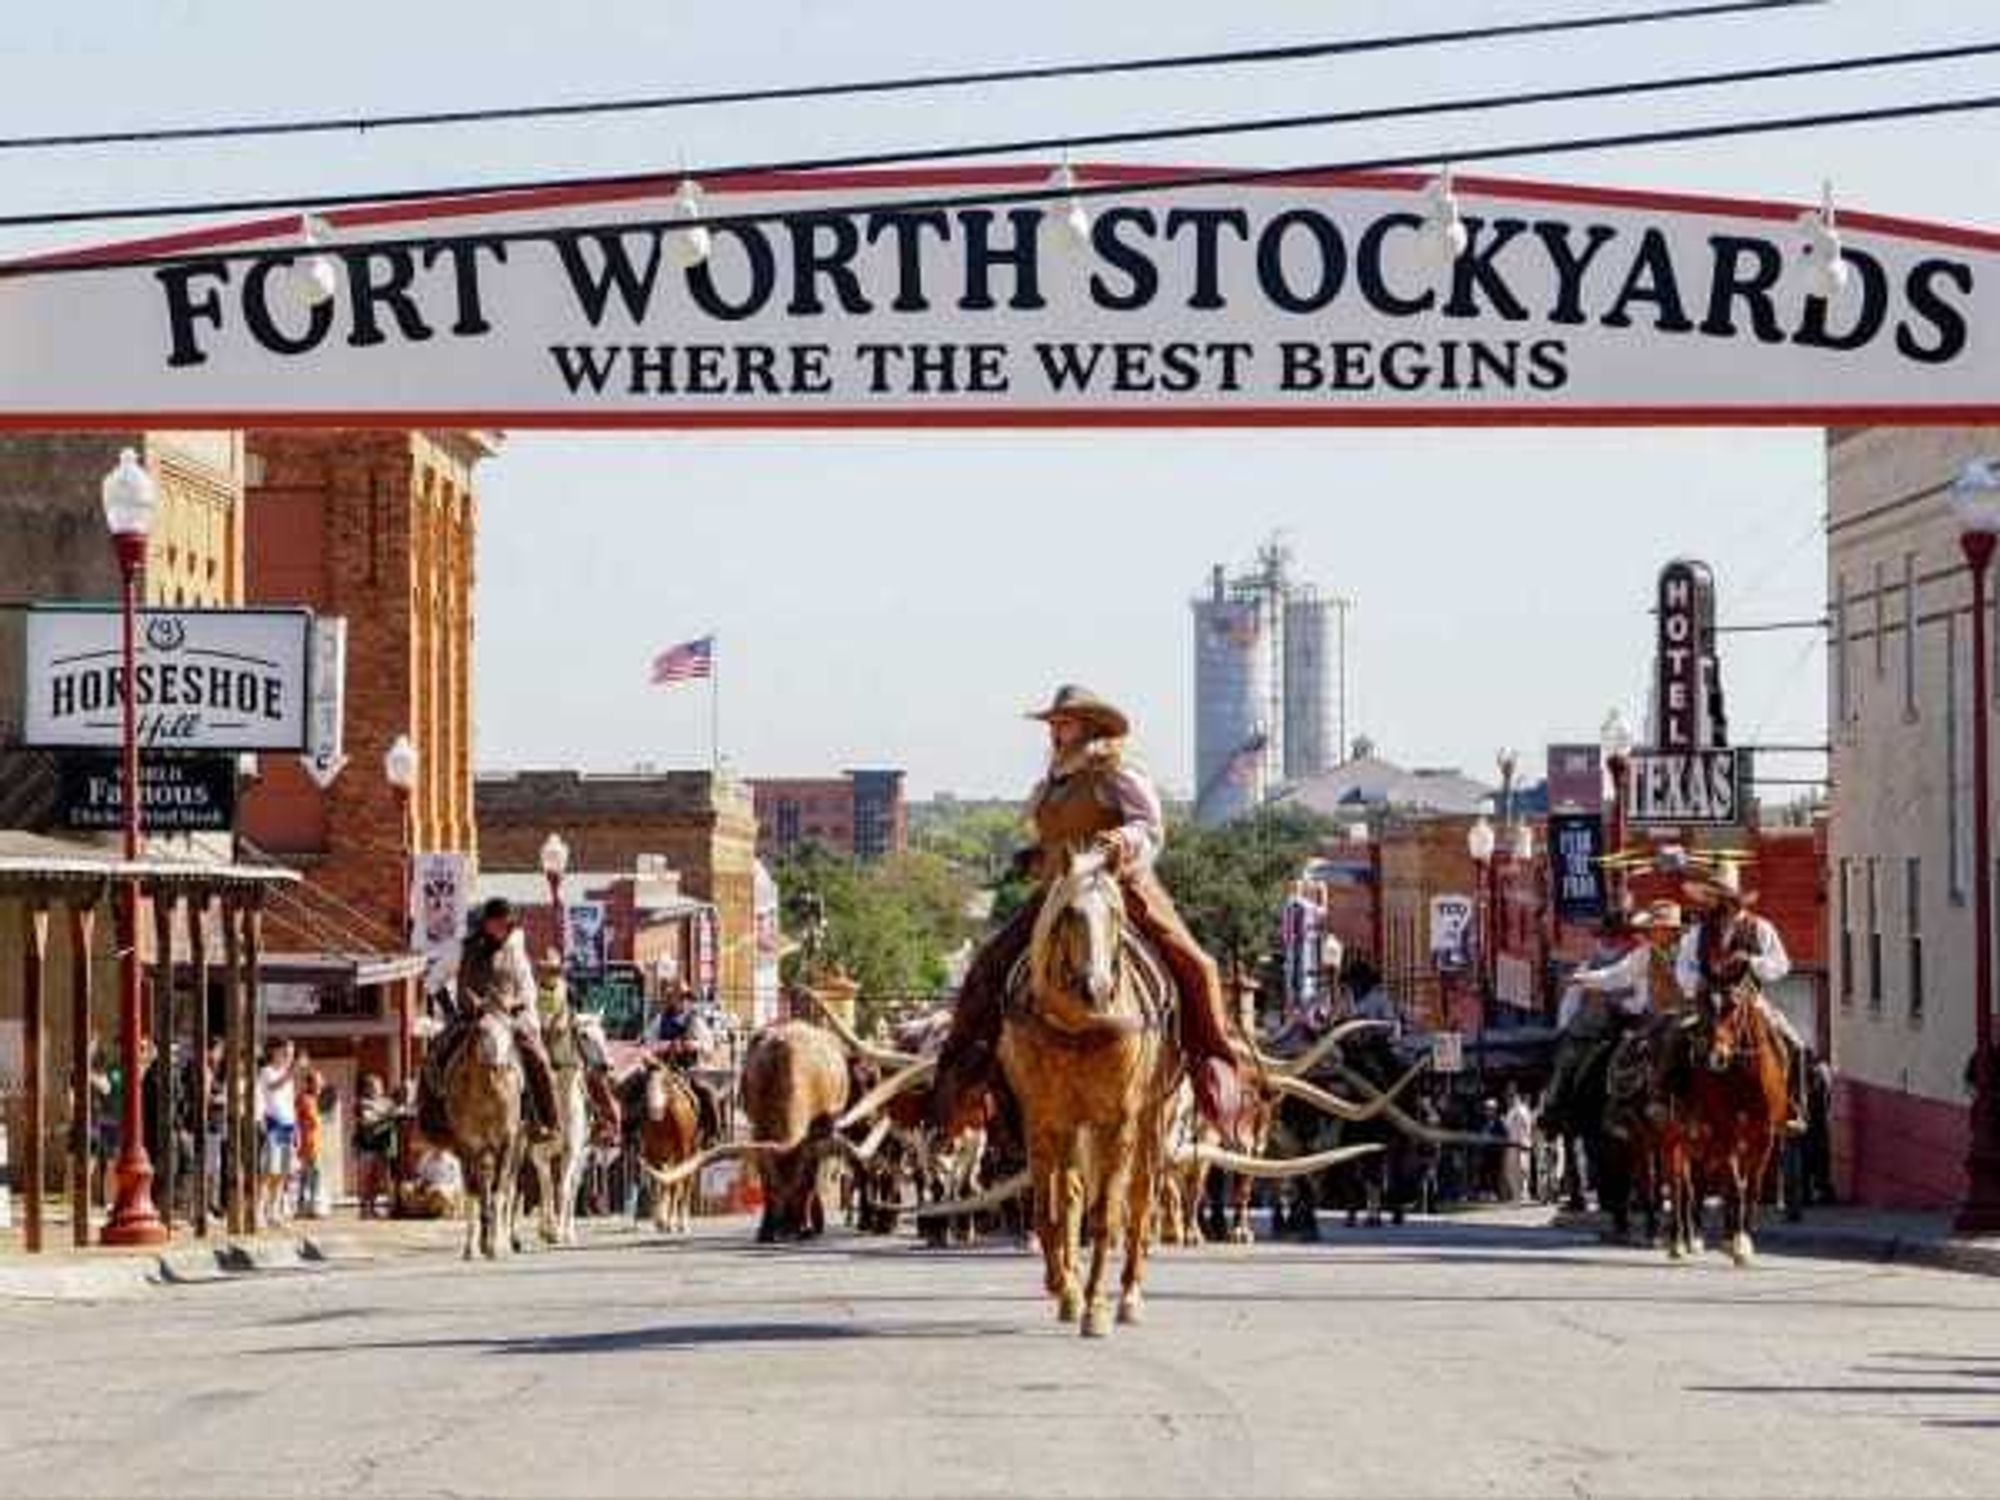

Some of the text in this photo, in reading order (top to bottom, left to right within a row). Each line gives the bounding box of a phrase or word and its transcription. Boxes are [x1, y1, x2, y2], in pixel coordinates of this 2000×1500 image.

[154, 206, 1973, 367] FORT WORTH STOCKYARDS
[548, 340, 1568, 395] WHERE THE WEST BEGINS
[1665, 578, 1691, 745] HOTEL
[1626, 752, 1736, 820] TEXAS
